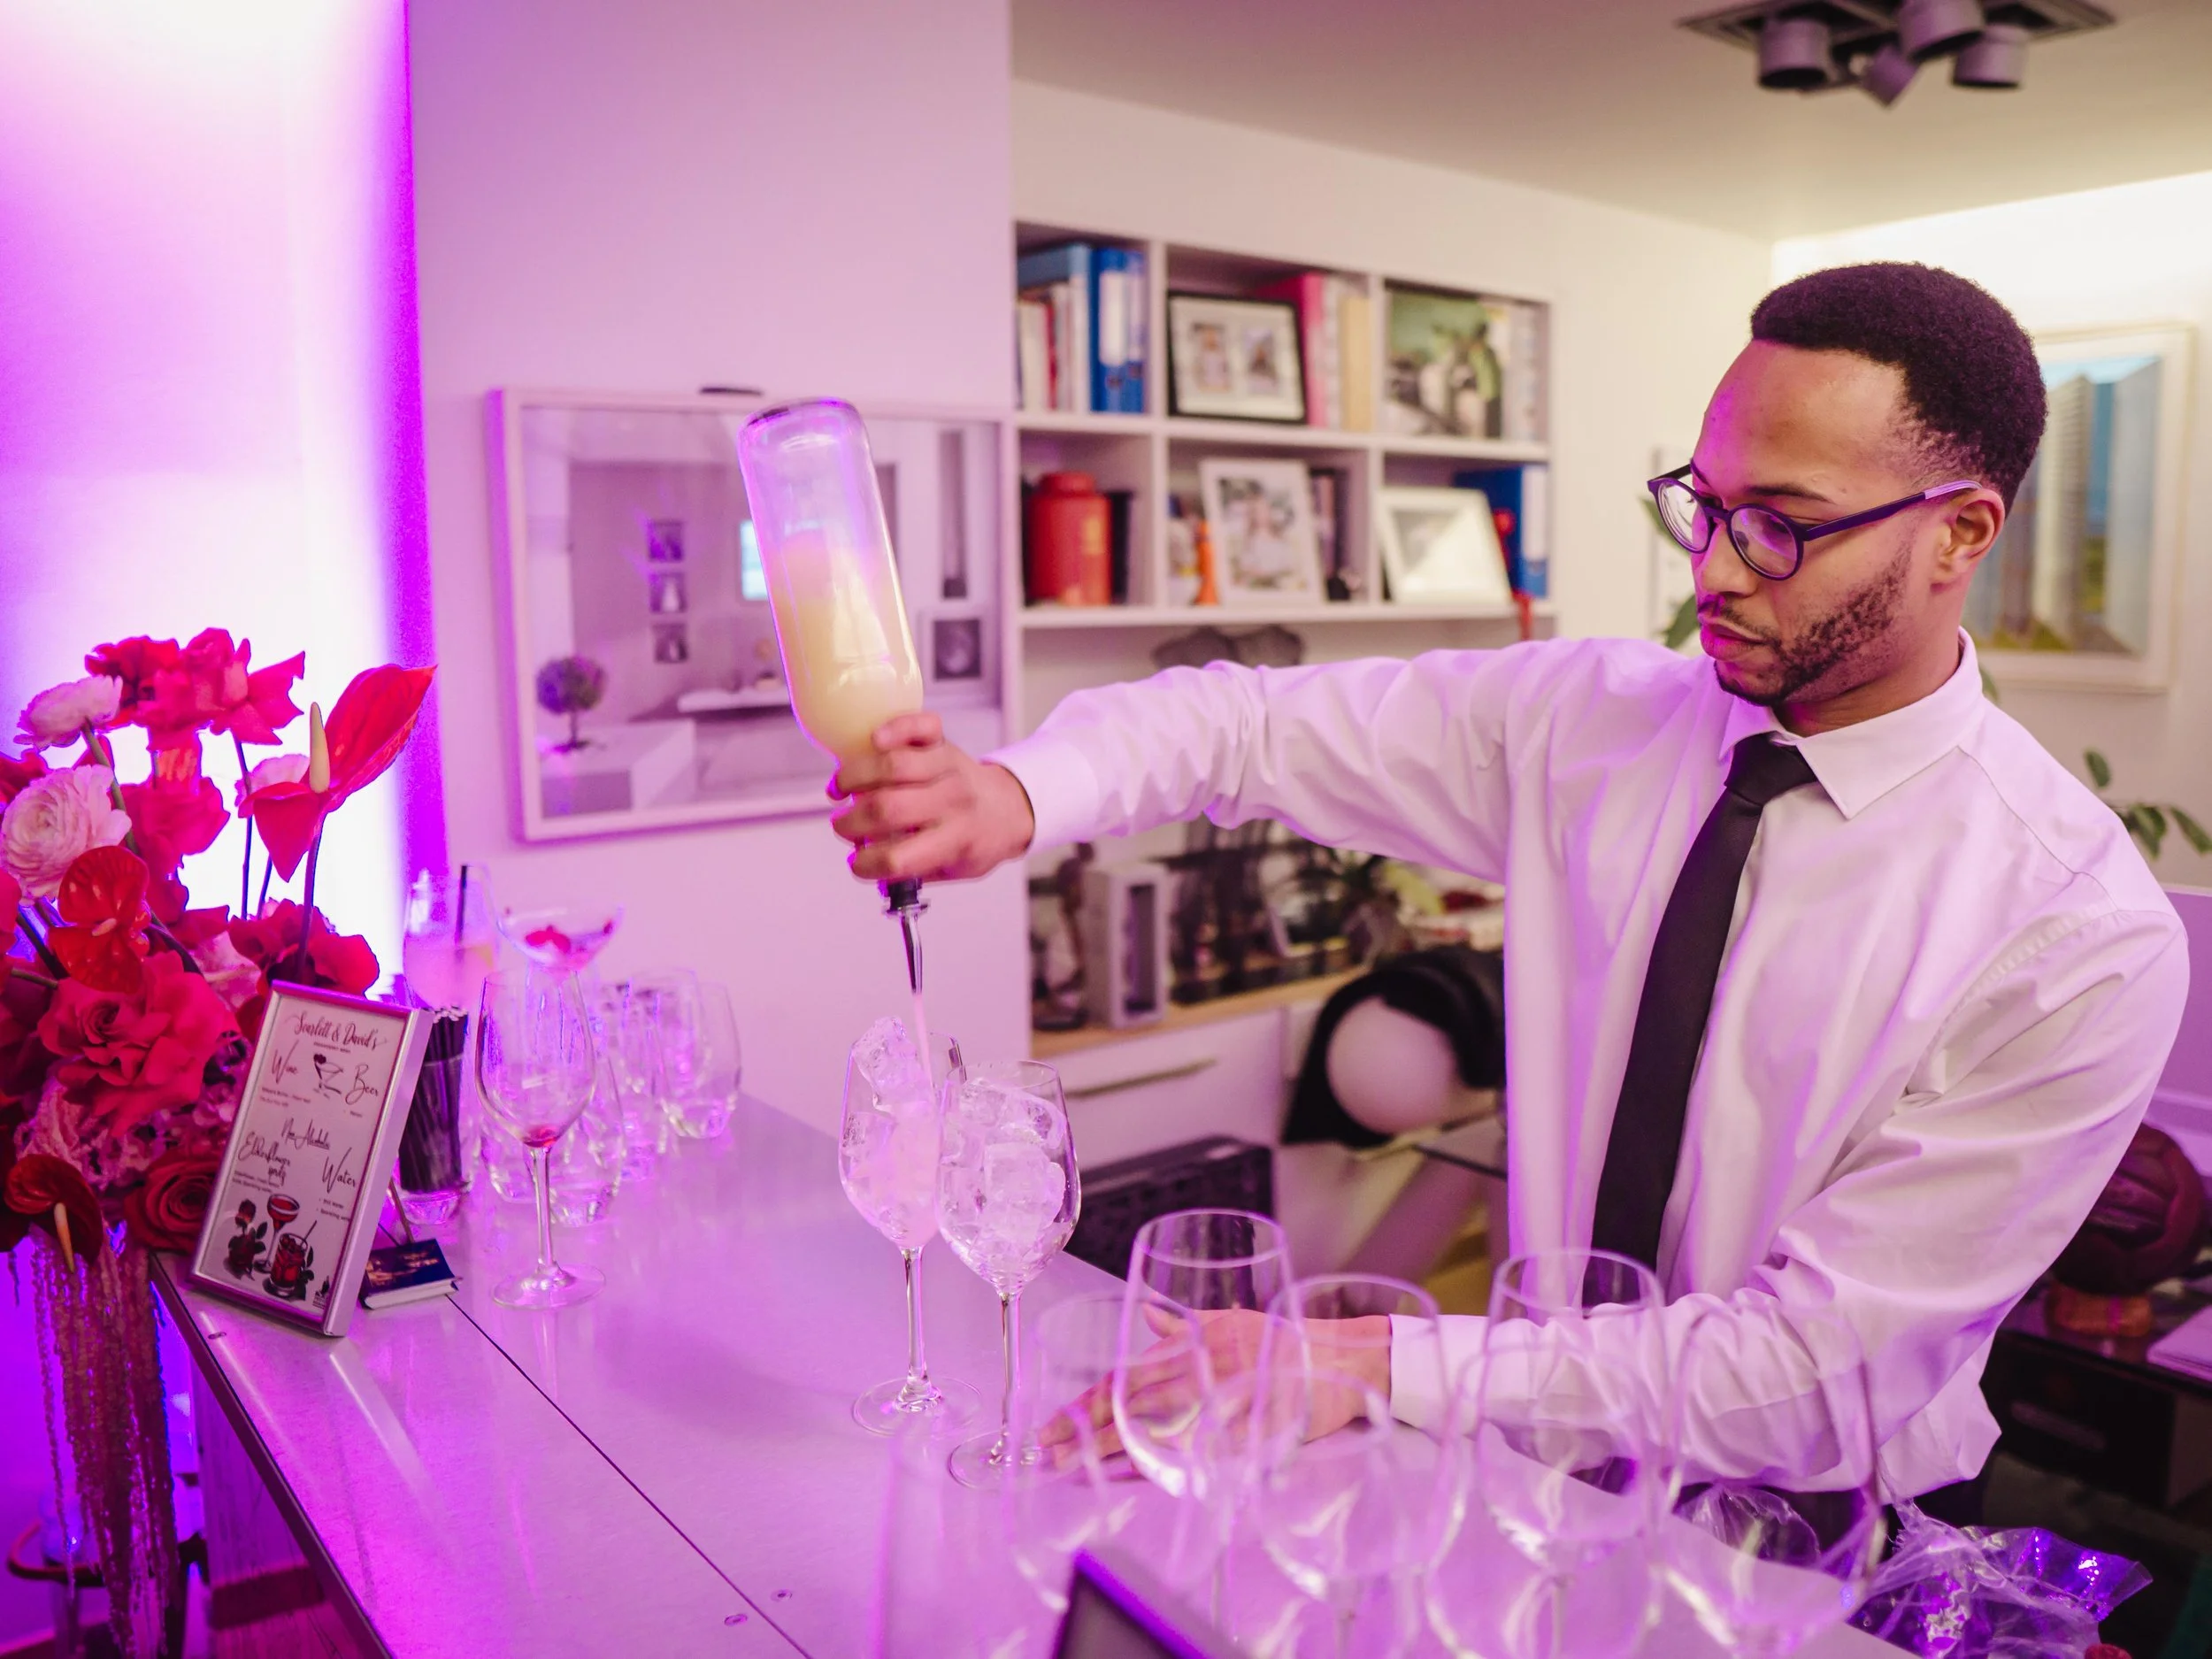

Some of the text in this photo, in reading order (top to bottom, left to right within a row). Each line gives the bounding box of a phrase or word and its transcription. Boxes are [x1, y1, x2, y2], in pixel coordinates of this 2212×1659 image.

[288, 1010, 332, 1038] Scarlett
[332, 1023, 342, 1042] &
[271, 1040, 299, 1085] Wine
[345, 1063, 379, 1105] Beer
[321, 1147, 356, 1194] Water
